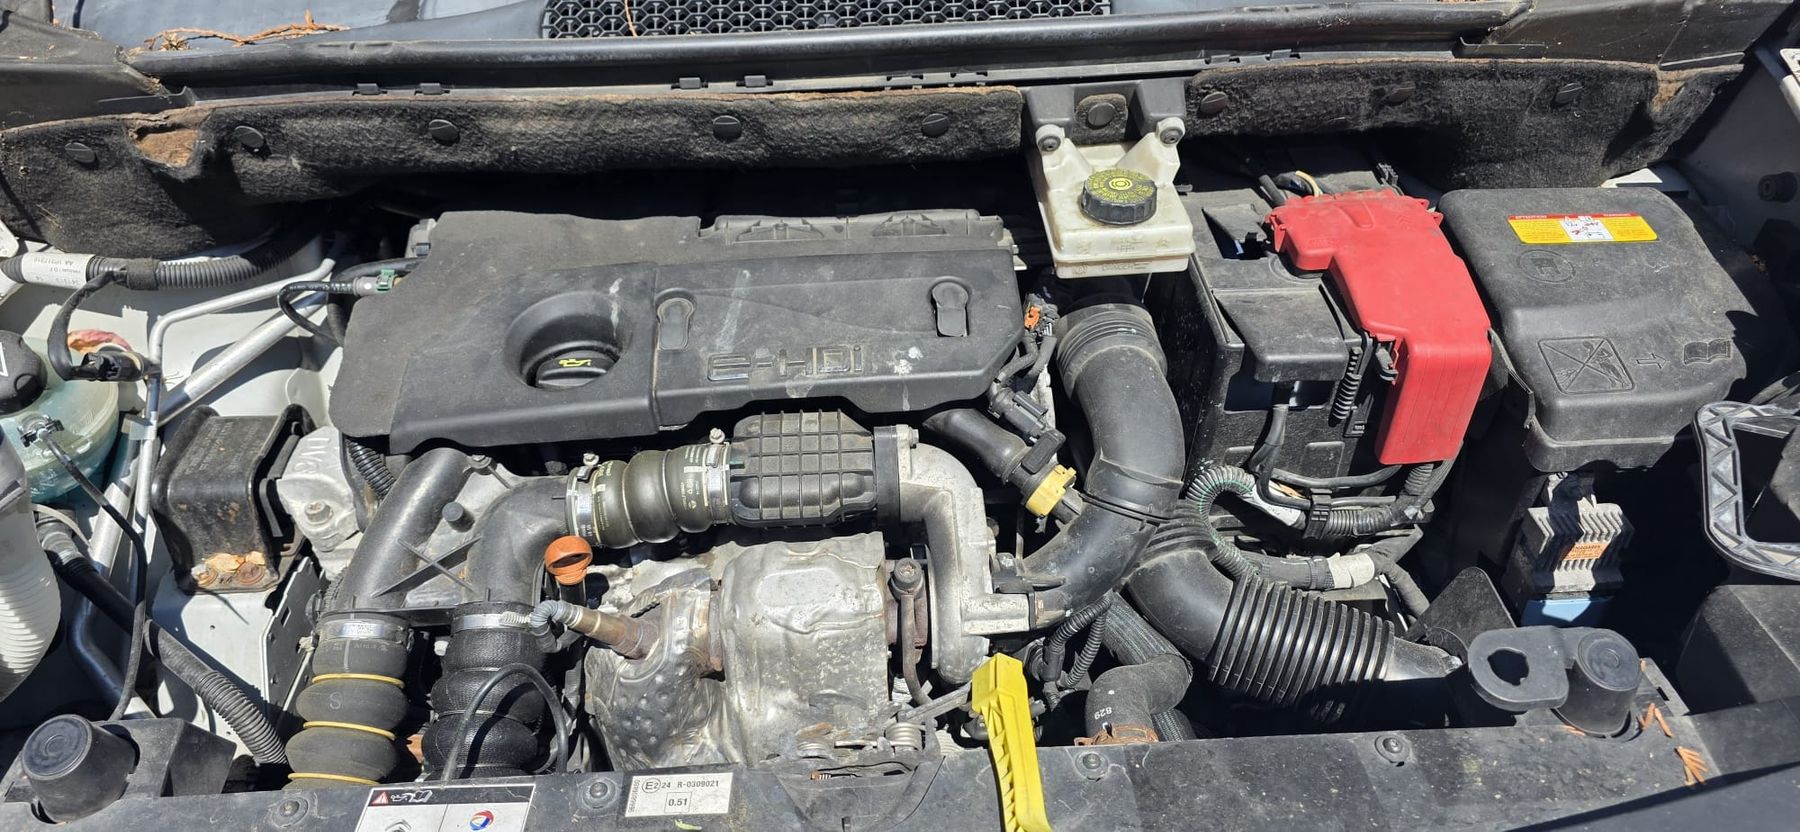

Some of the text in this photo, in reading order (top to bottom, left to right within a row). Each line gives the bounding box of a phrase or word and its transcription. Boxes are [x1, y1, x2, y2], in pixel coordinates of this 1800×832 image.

[1094, 706, 1113, 720] 829
[661, 781, 671, 789] 24
[677, 780, 719, 788] R-0309021
[668, 798, 688, 807] 0.51
